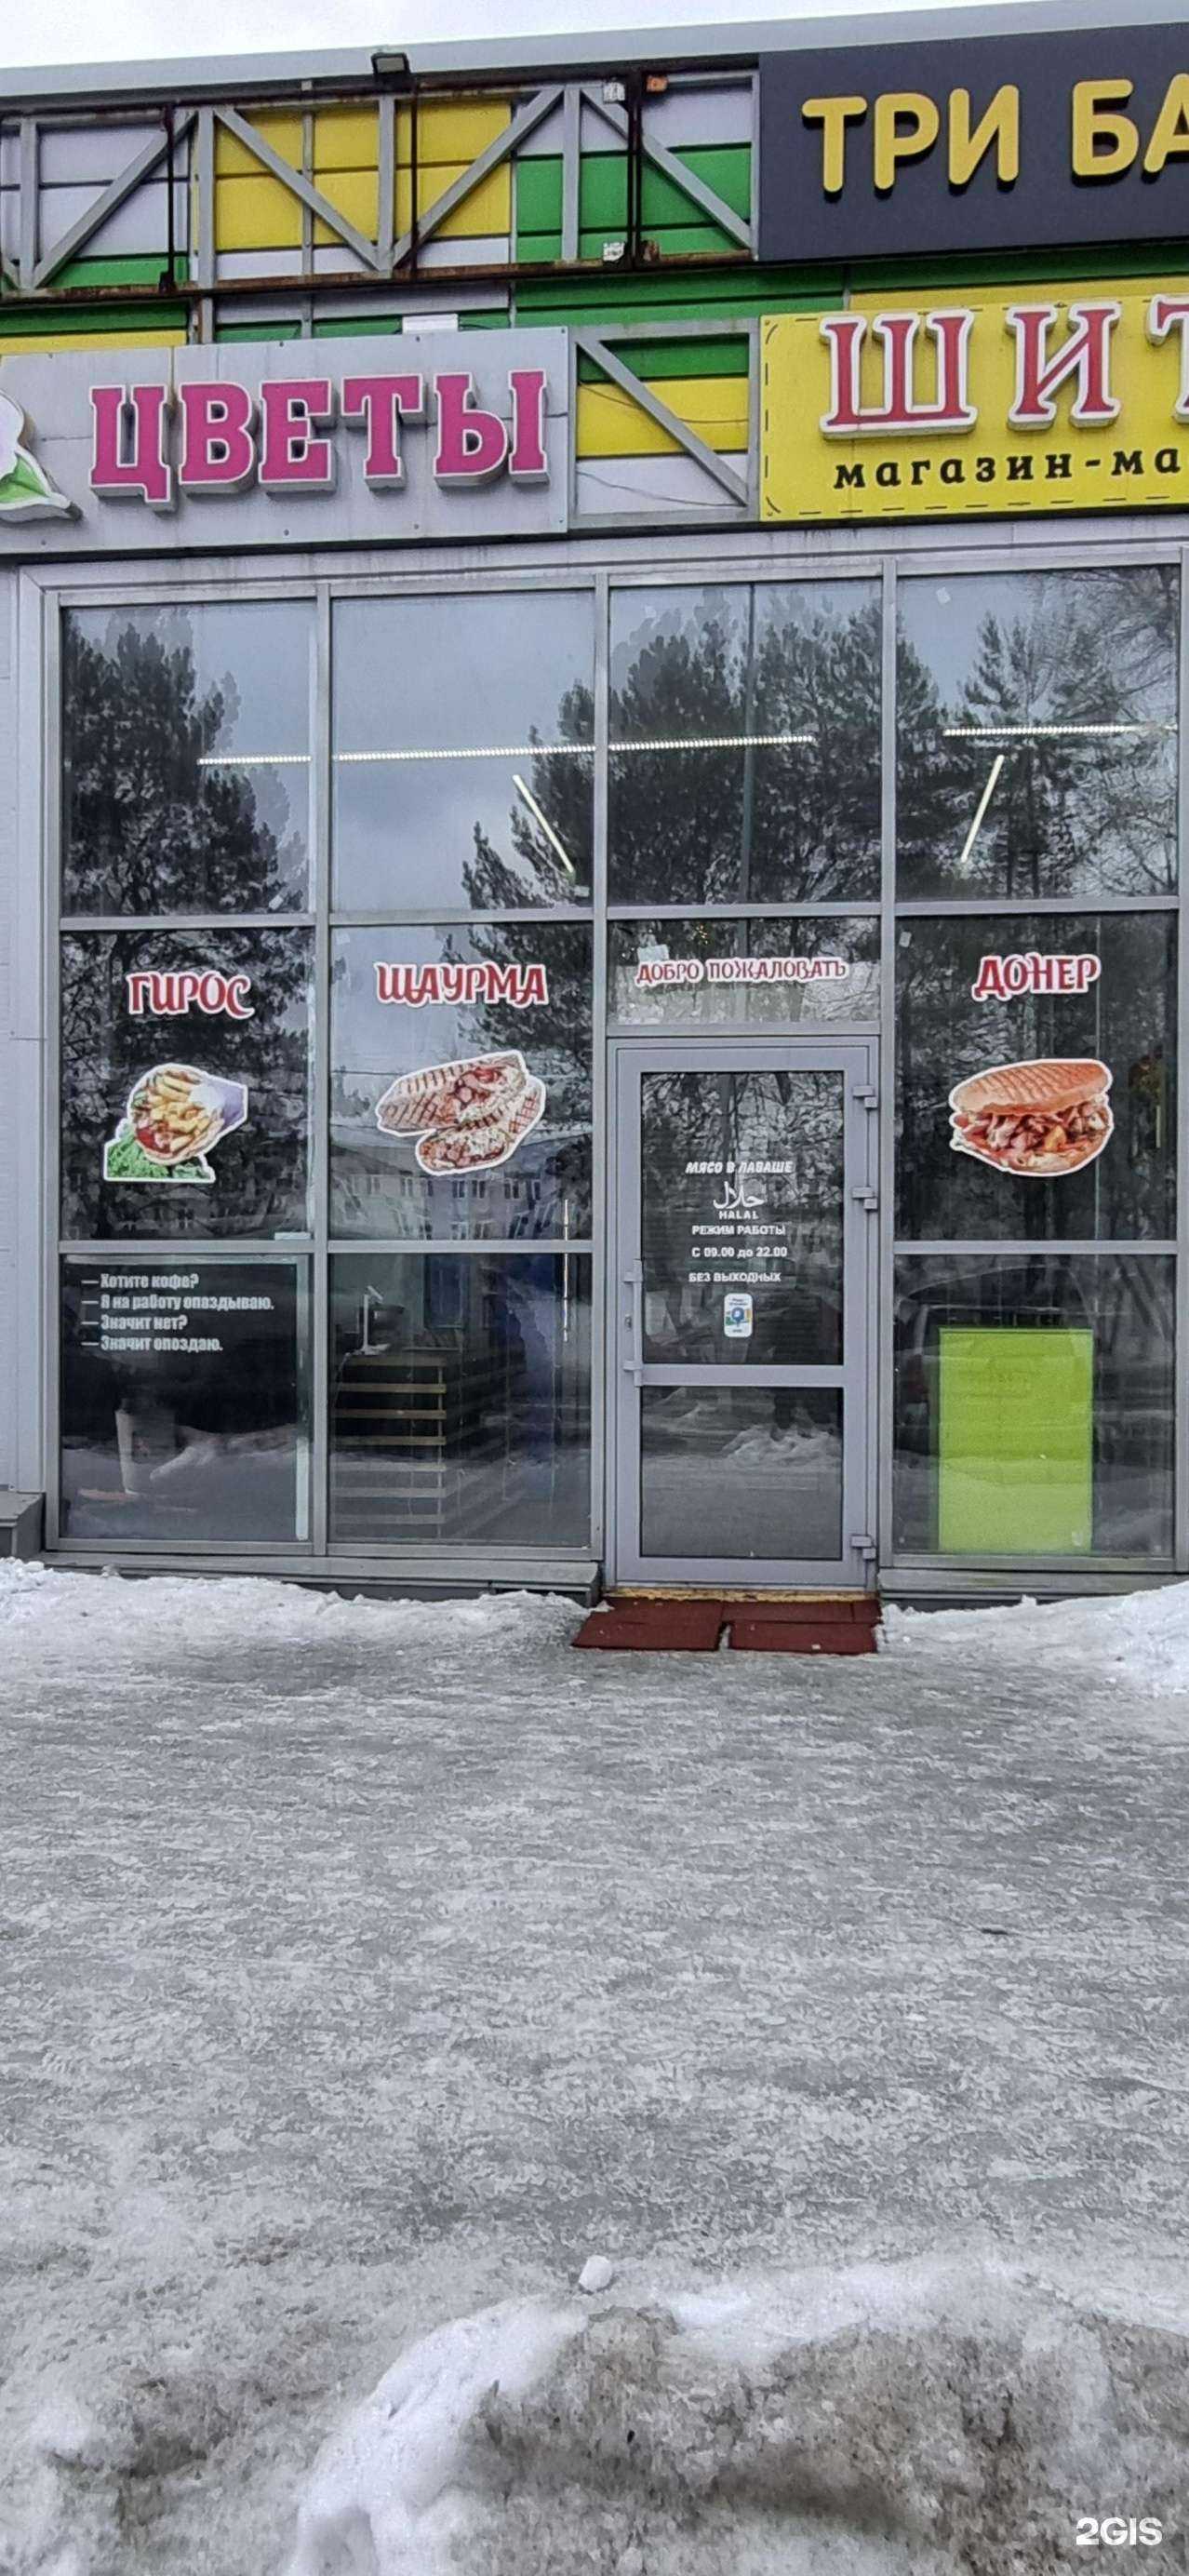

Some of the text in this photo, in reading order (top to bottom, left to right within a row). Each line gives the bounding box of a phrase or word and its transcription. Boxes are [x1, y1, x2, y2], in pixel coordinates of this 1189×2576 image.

[802, 84, 1020, 193] ТРИ
[90, 369, 548, 504] ЦВЕТЫ
[834, 448, 1181, 489] магазин-ма
[636, 958, 848, 985] ДОБРО ПОЖАЛОВАТЬ
[973, 954, 1100, 999] ДОНЕР
[375, 962, 547, 1005] ШАУРМА
[127, 972, 254, 1017] ГИРОС
[685, 1161, 794, 1174] МЯСО В ЛАВАШЕ
[713, 1181, 765, 1209] حلال
[718, 1211, 759, 1219] HALAL
[691, 1225, 786, 1235] РЕЖИМ РАБОТЫ
[691, 1246, 787, 1259] С 09.00 до 22.00
[100, 1274, 149, 1288] Хотите
[152, 1273, 199, 1290] кофе?
[688, 1272, 782, 1283] БЕЗ ВЫХОДНЫХ
[100, 1295, 110, 1309] Я
[113, 1296, 130, 1309] на
[132, 1295, 181, 1310] работу
[183, 1295, 274, 1311] опаздываю.
[100, 1315, 152, 1329] Значит
[154, 1314, 188, 1330] нет?
[100, 1335, 152, 1350] Значит
[154, 1337, 223, 1353] опоздаю.
